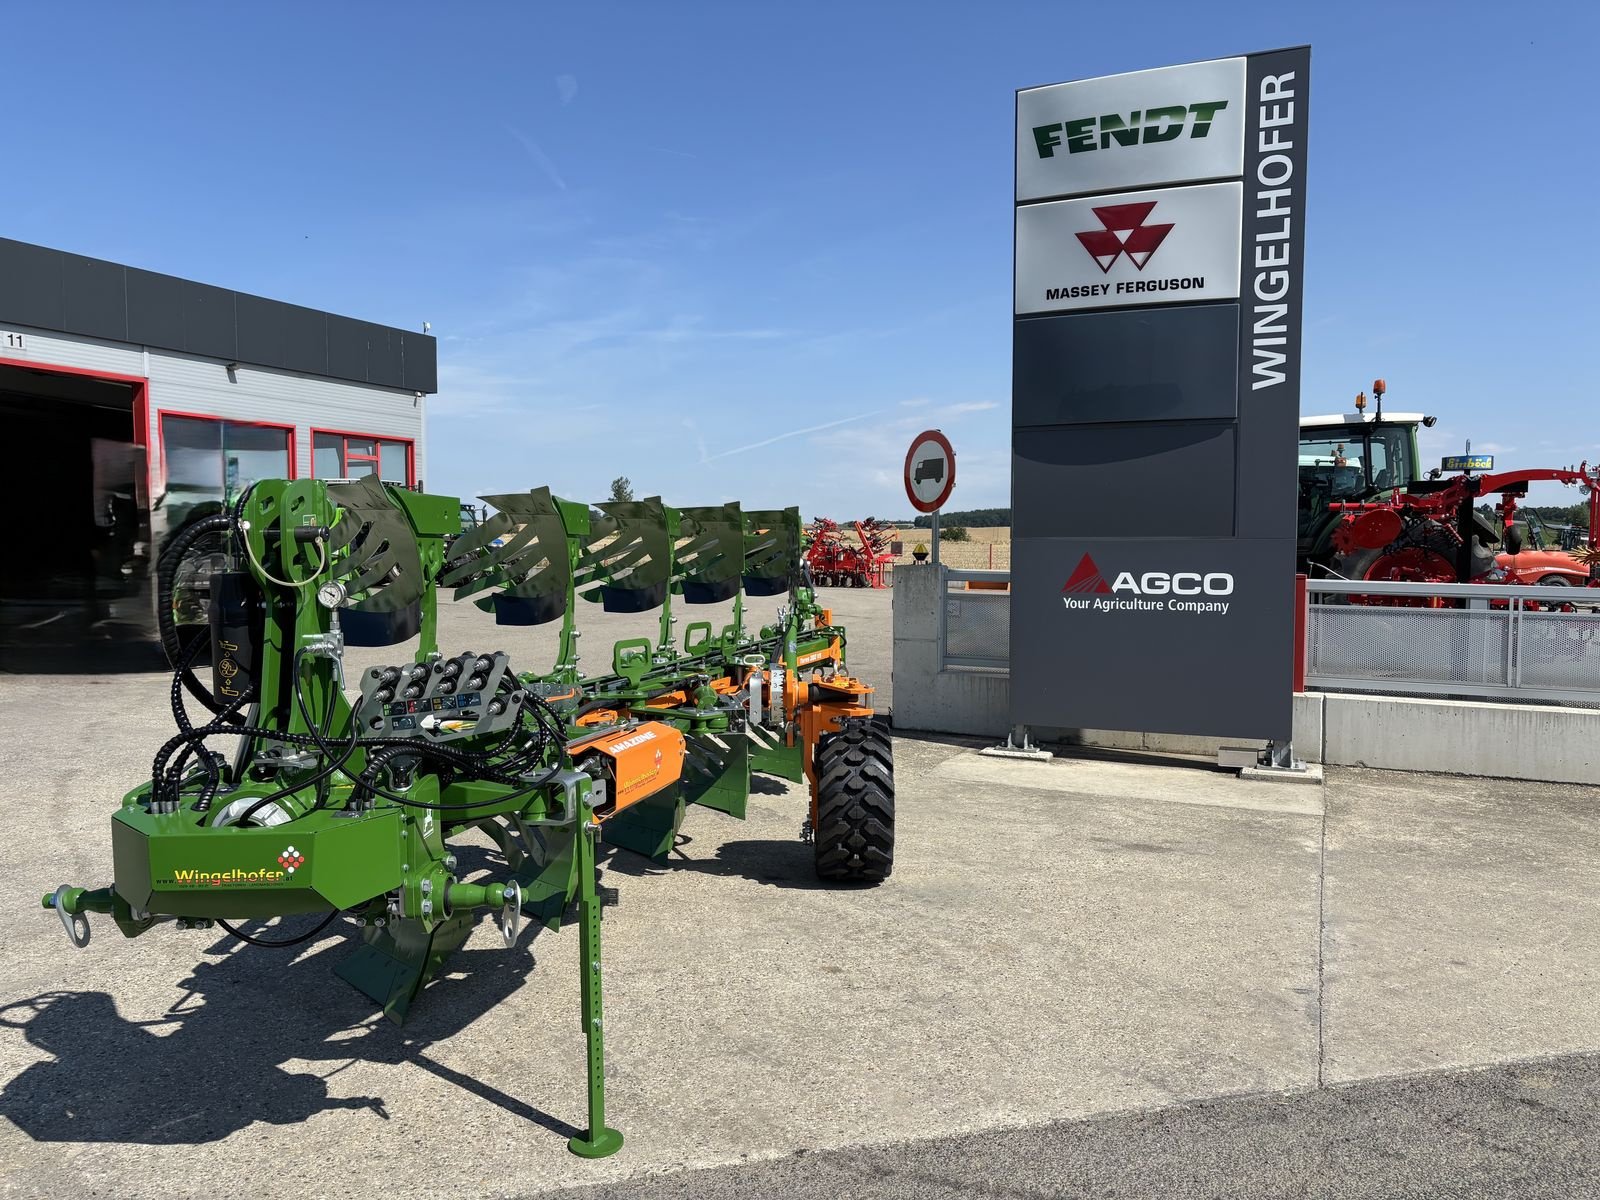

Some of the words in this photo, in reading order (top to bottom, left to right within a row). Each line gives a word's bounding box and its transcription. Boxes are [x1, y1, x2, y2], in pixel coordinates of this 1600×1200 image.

[1032, 100, 1228, 159] FENDT
[1252, 70, 1295, 390] WINGELHOFER
[1046, 284, 1110, 300] MASSEY
[1116, 277, 1205, 294] FERGUSON
[7, 334, 22, 347] 11
[1446, 457, 1491, 469] Einböck
[1112, 572, 1234, 595] AGCO
[1063, 597, 1090, 609] Your
[1093, 598, 1164, 612] Agriculture
[1168, 599, 1229, 615] Company
[609, 731, 657, 753] AMAZONE
